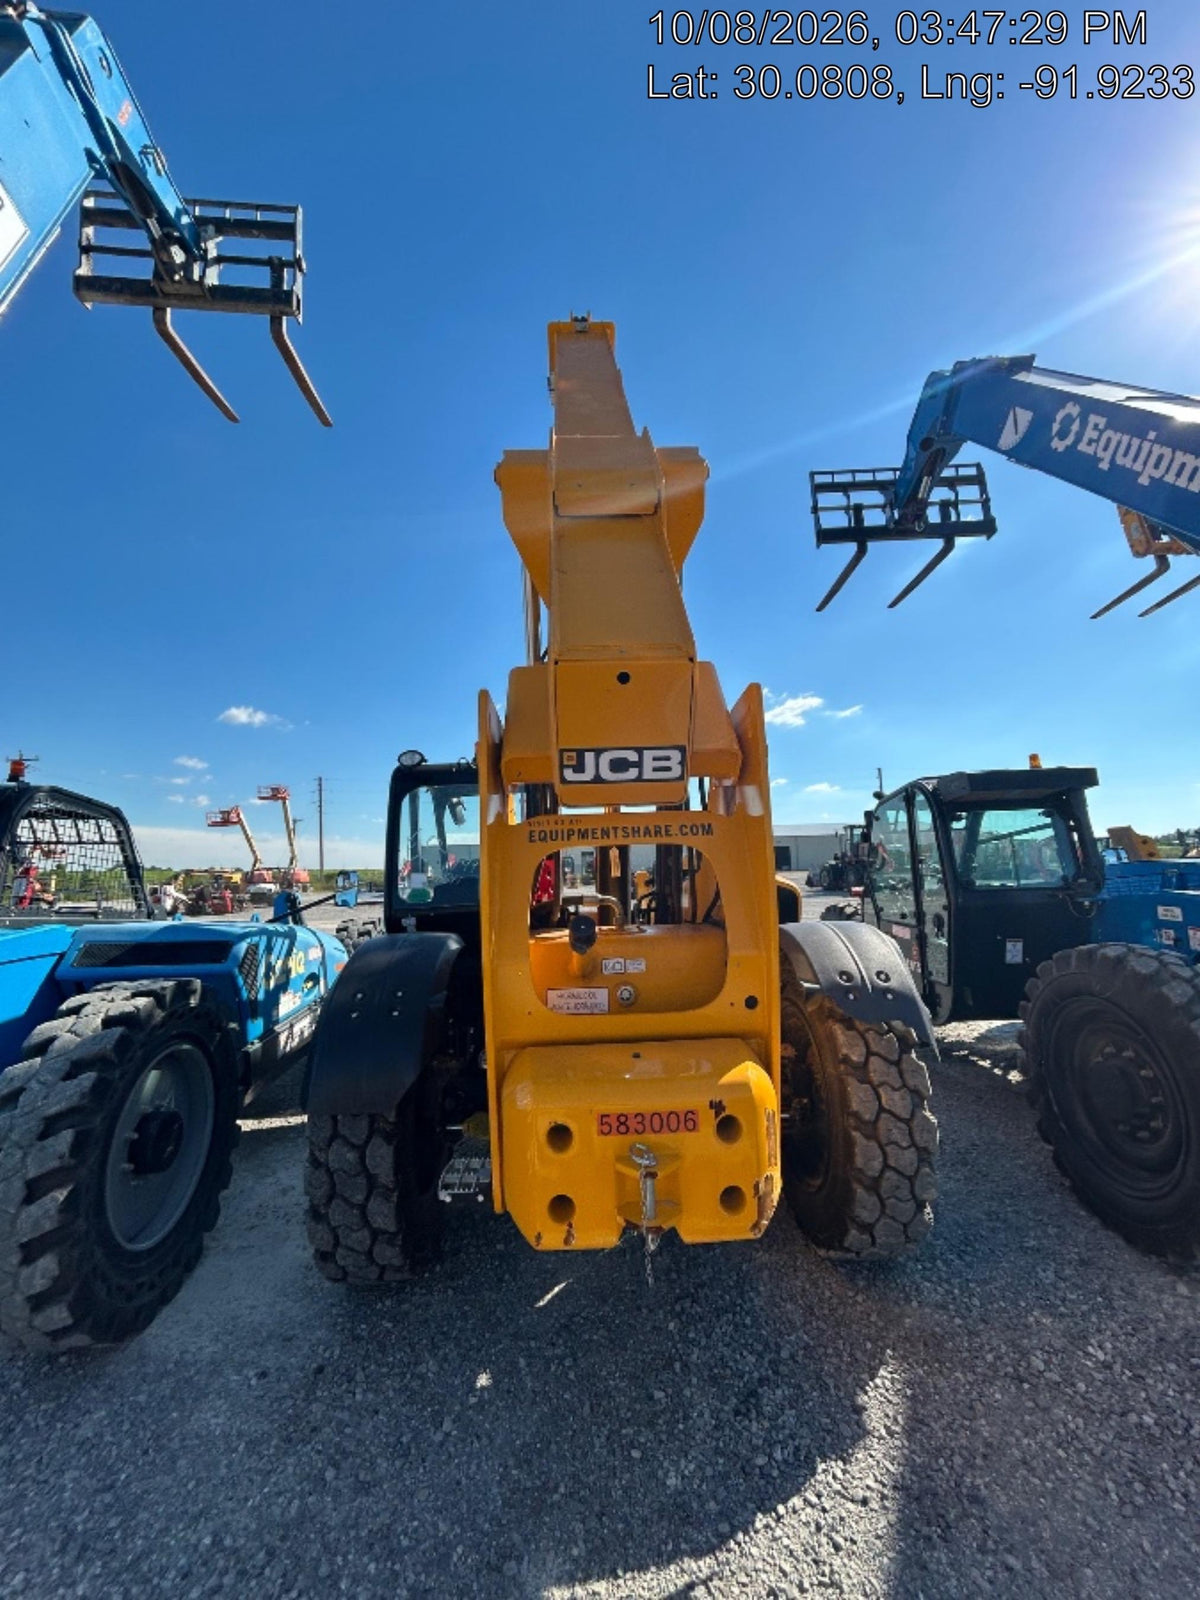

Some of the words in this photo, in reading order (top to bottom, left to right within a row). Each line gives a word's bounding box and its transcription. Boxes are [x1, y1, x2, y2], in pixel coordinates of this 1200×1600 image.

[562, 749, 682, 781] JCB
[528, 822, 714, 843] EQUIPMENTSHARE.COM
[600, 1110, 697, 1136] 583006
